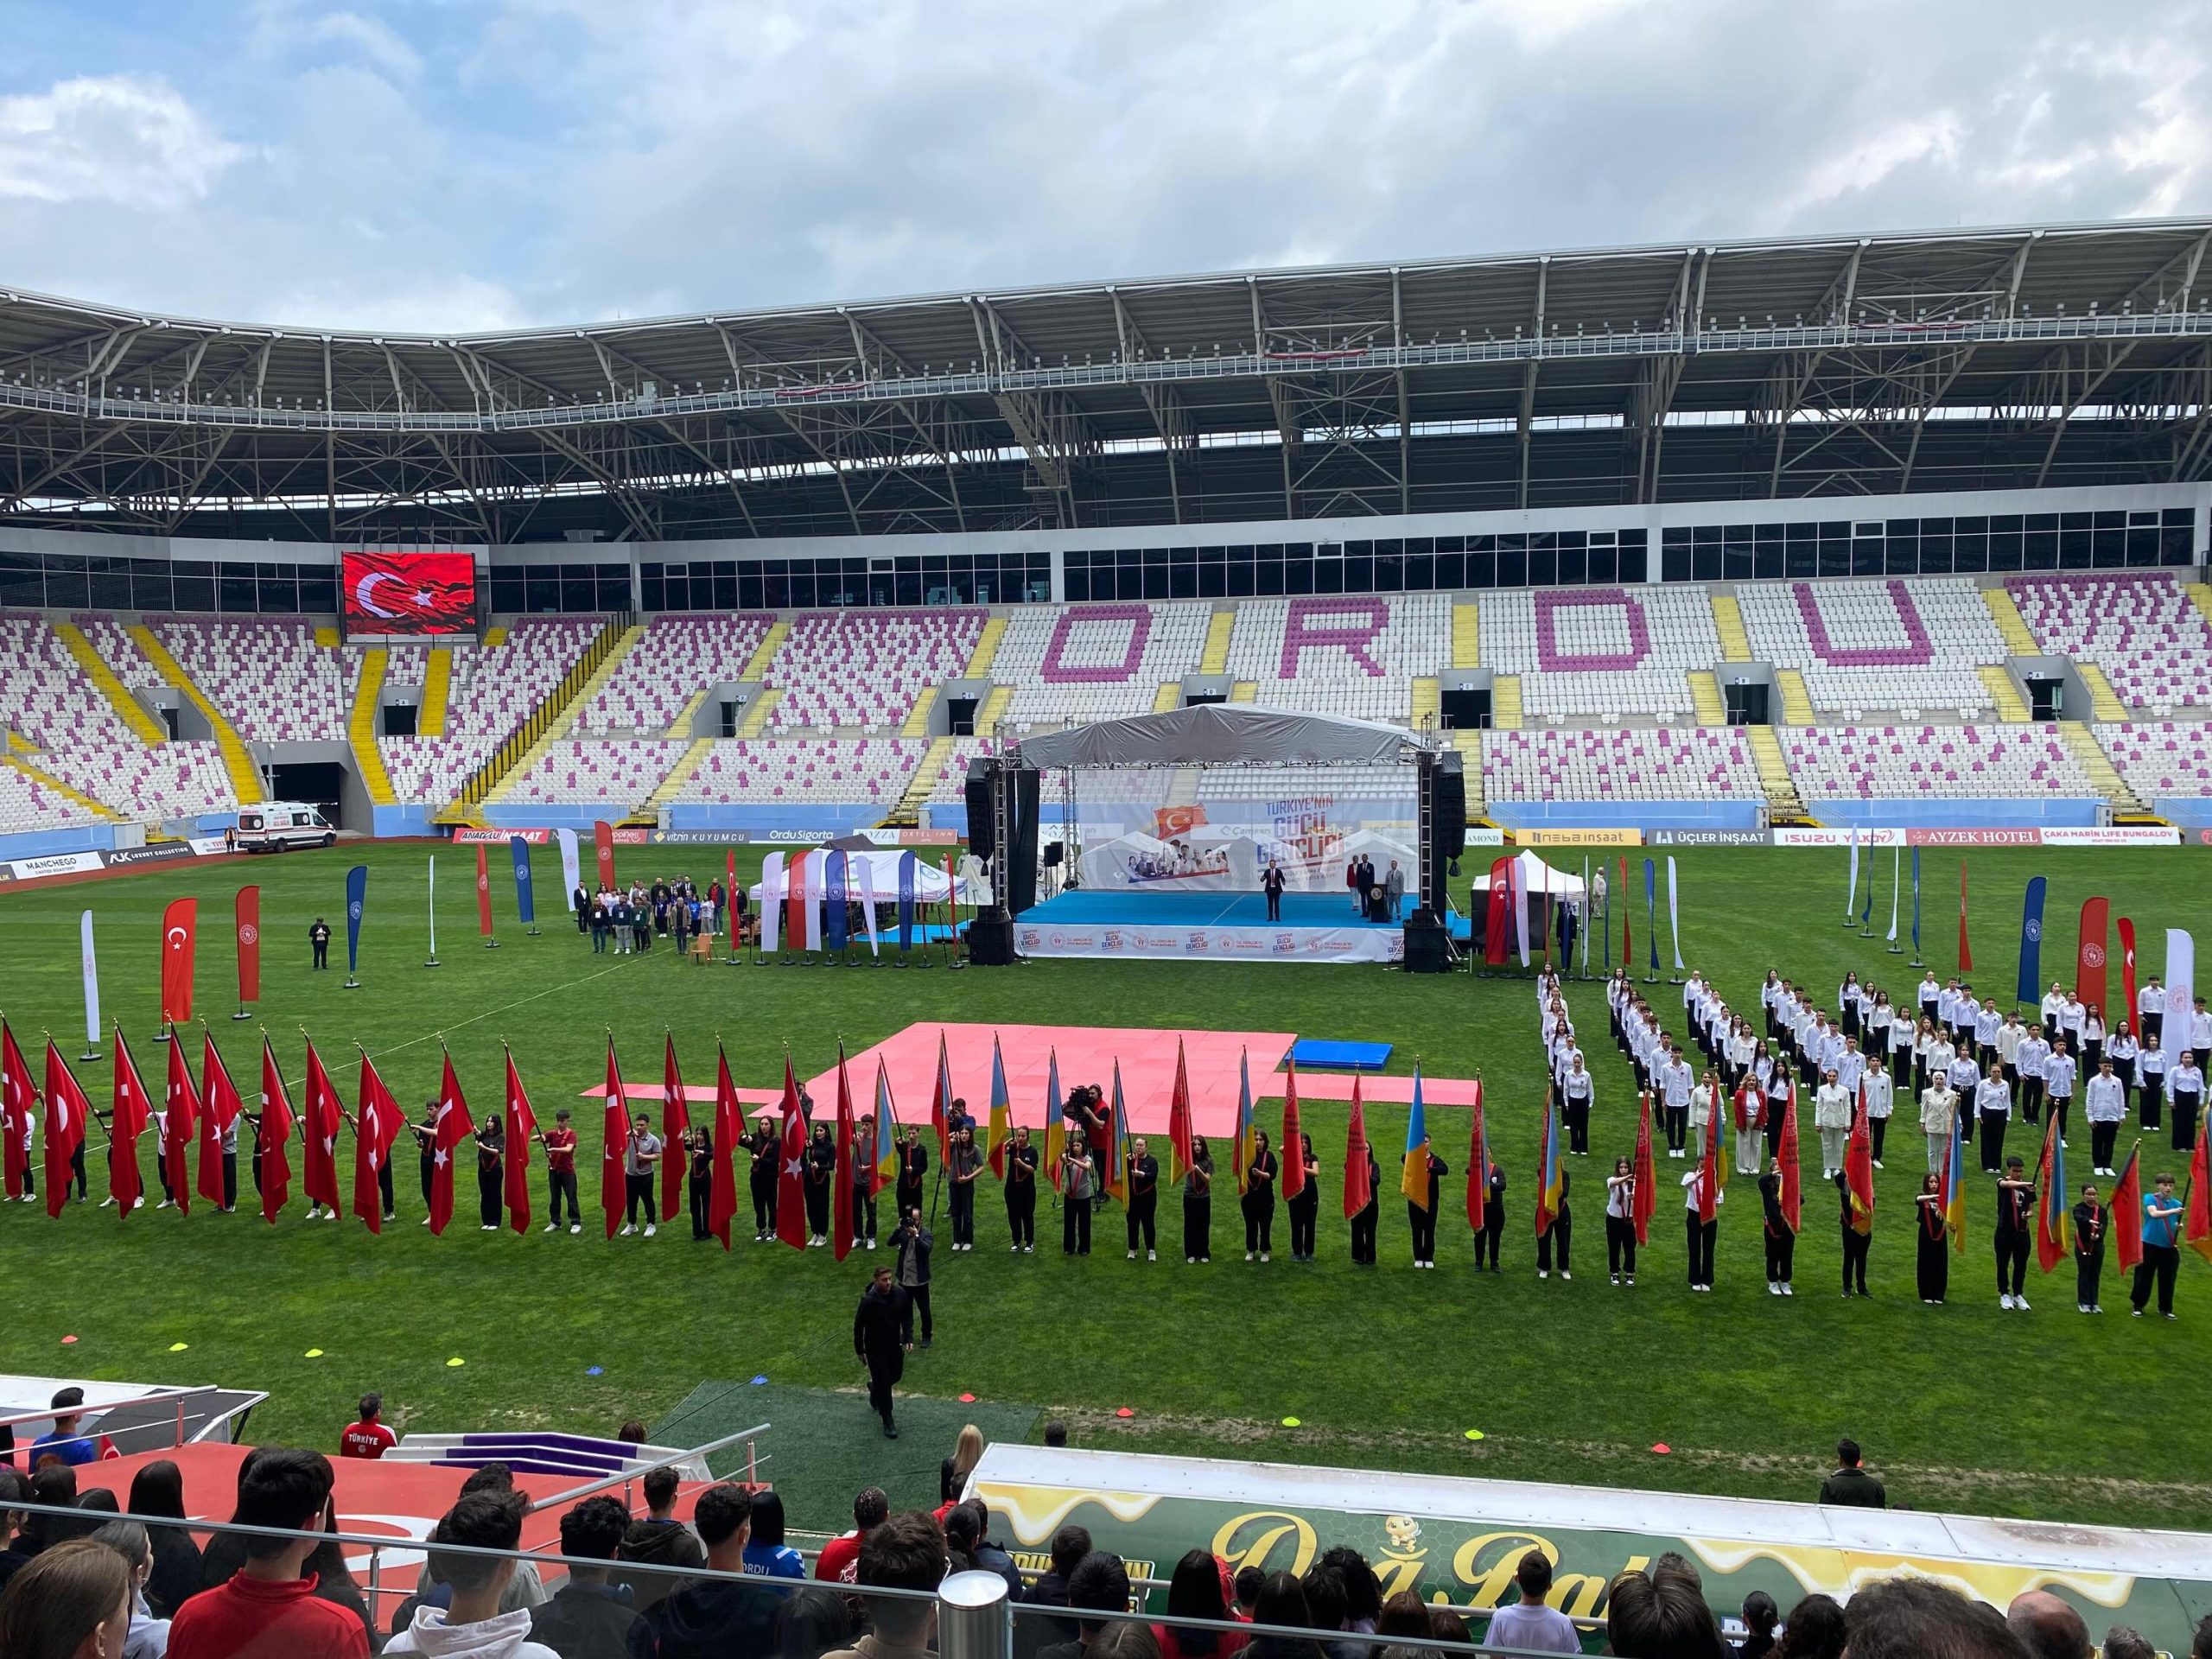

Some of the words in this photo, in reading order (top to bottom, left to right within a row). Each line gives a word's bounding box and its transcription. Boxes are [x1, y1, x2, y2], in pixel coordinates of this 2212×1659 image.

[1274, 811, 1325, 838] GÜCÜ
[691, 832, 744, 842] KUYUMCU
[769, 830, 796, 840] Ordu
[798, 830, 834, 842] Sigorta
[1678, 831, 1719, 844] ÜÇLER
[1721, 830, 1764, 845] İNŞAAT
[1785, 834, 1836, 842] ISUZU
[1928, 831, 1976, 842] AYZEK
[1983, 831, 2037, 843] HOTEL
[155, 847, 189, 856] COLLECTION
[26, 858, 77, 870] MANCHEGO
[348, 1433, 378, 1446] TÜRKİYE
